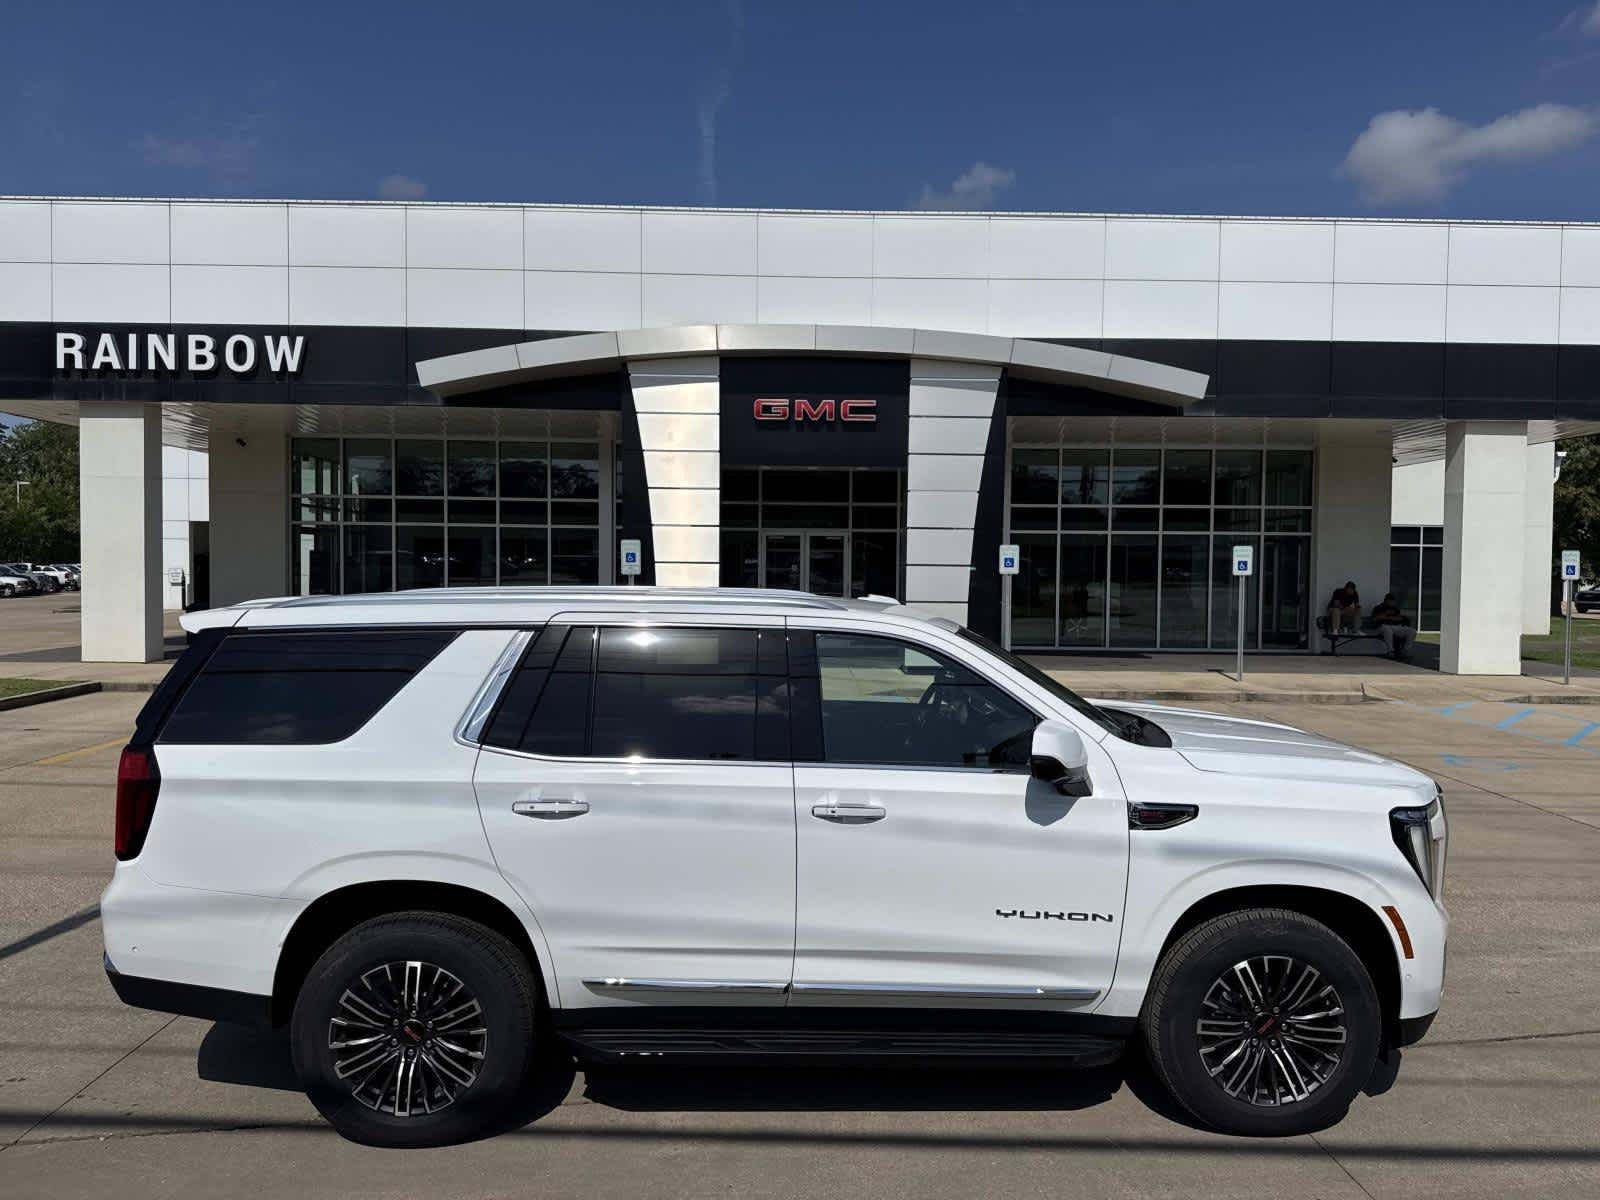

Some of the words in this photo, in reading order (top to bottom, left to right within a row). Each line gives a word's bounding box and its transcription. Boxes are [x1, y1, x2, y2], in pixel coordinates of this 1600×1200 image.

[56, 332, 305, 373] RAINBOW
[753, 398, 877, 421] GMC
[995, 908, 1114, 923] YUKON
